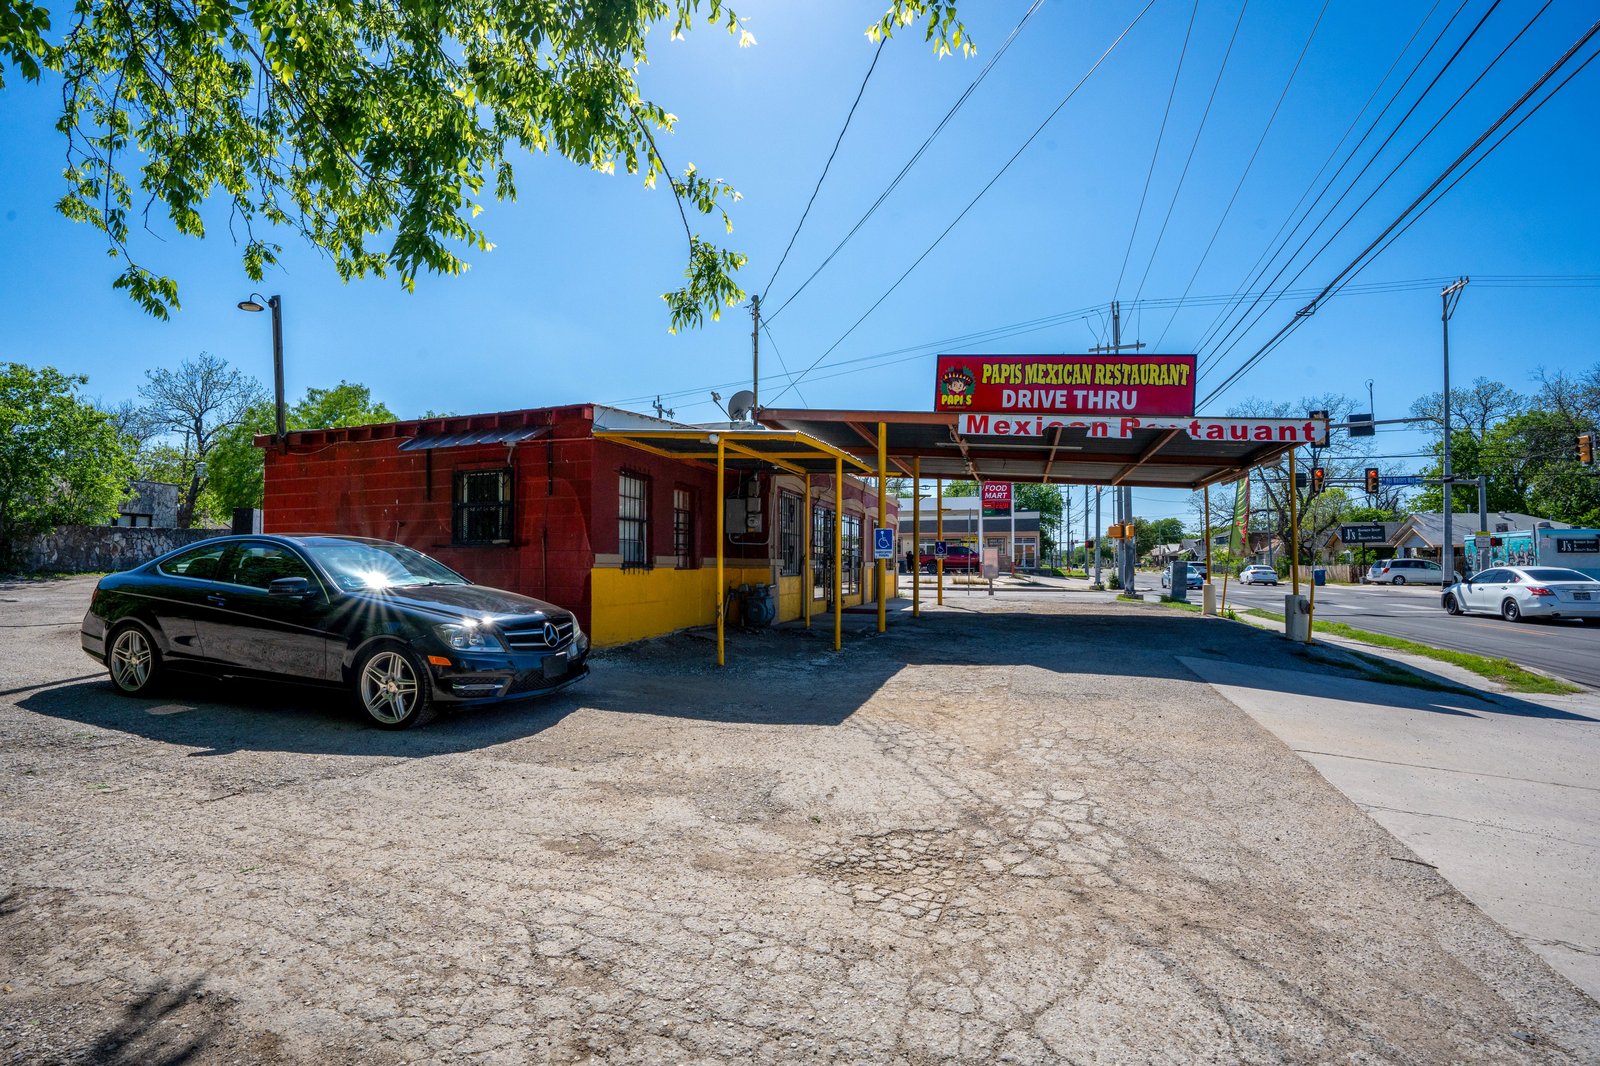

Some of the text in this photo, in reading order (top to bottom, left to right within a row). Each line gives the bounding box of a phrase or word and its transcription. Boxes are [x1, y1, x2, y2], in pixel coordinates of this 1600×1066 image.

[981, 363, 1190, 386] PAPIS MEXICAN RESTAURANT
[1002, 389, 1137, 410] DRIVE THRU
[966, 414, 1315, 441] Mexin Rtauant
